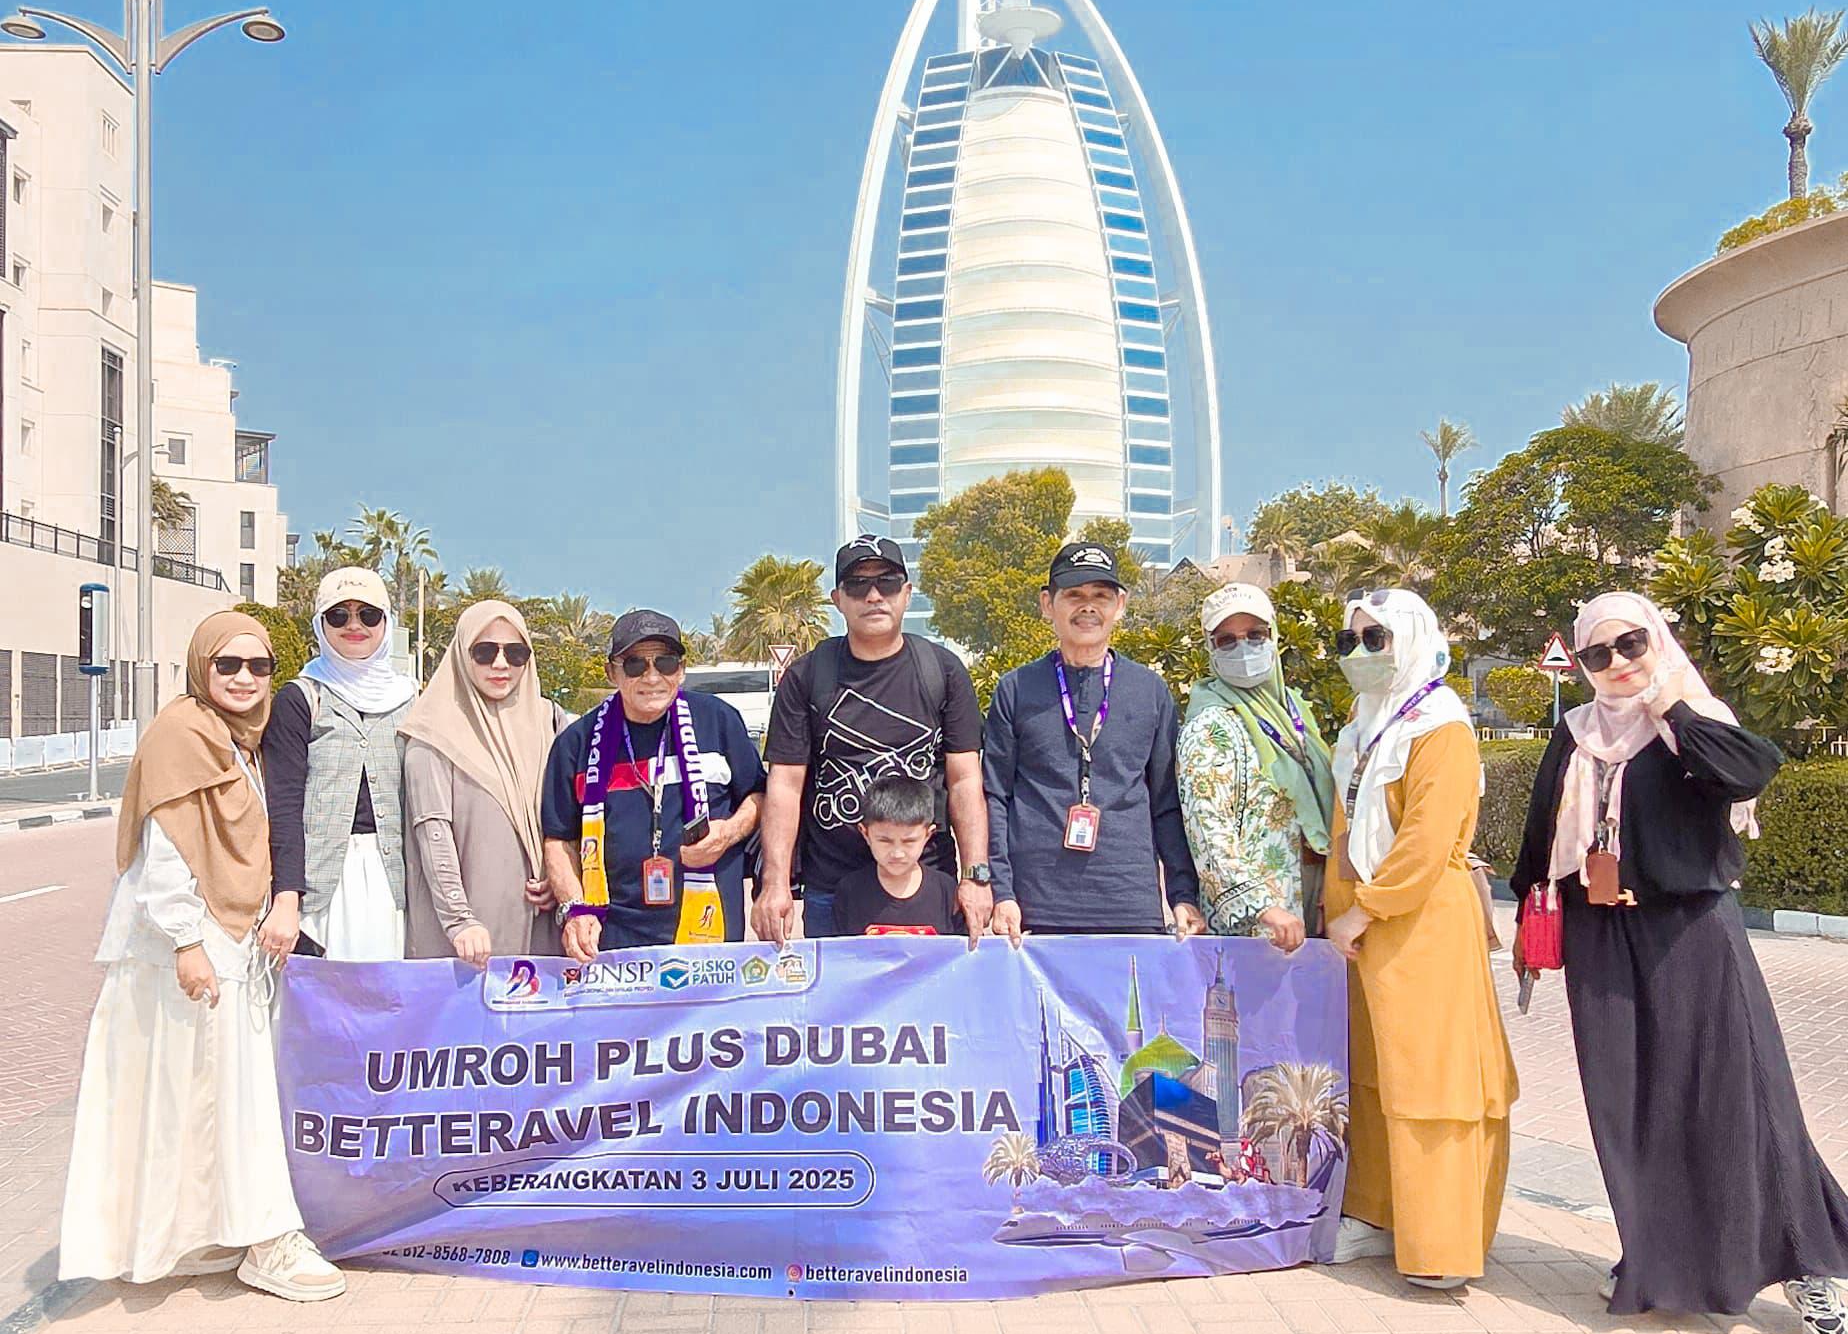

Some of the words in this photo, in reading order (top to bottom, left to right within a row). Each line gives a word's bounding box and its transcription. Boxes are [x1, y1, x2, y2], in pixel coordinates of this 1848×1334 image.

[584, 961, 654, 984] BNSP
[692, 959, 735, 973] SISKO
[692, 972, 734, 985] PATUH
[367, 1042, 573, 1093] UMROH
[597, 1027, 745, 1080] PLUS
[764, 1025, 947, 1066] DUBAI
[294, 1099, 662, 1158] BETTERAVEL
[684, 1090, 1022, 1134] INDONESIA
[452, 1170, 683, 1193] KEBERANGKATAN
[691, 1169, 707, 1190] 3
[716, 1169, 779, 1190] JULI
[788, 1169, 856, 1190] 2025
[541, 1253, 772, 1280] www.betteravelindonesia.com
[805, 1264, 968, 1283] betteravelindonesia
